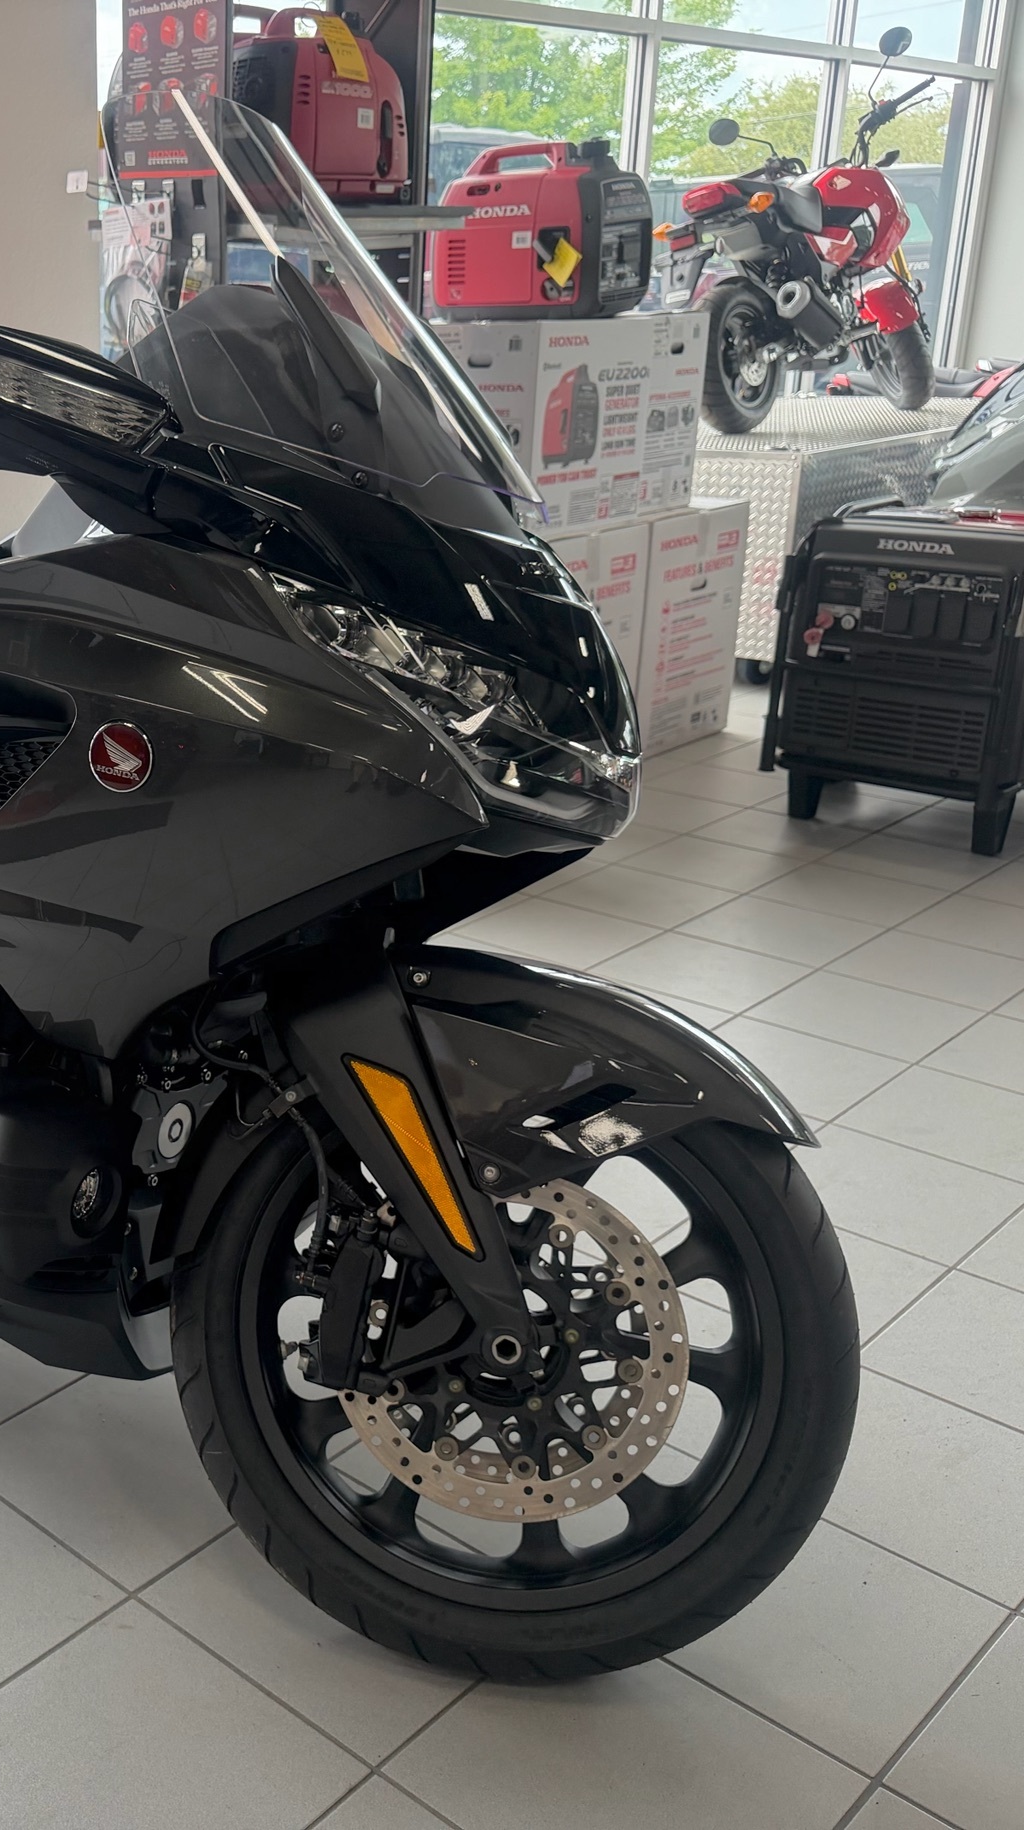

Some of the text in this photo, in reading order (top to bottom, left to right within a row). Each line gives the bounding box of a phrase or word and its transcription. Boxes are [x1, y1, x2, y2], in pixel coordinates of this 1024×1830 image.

[140, 4, 160, 15] Honda
[148, 150, 187, 158] HONDA
[549, 335, 590, 348] HONDA
[478, 384, 524, 393] HONDA
[660, 534, 699, 552] HONDA
[877, 537, 955, 556] HONDA
[96, 764, 140, 781] HONDA
